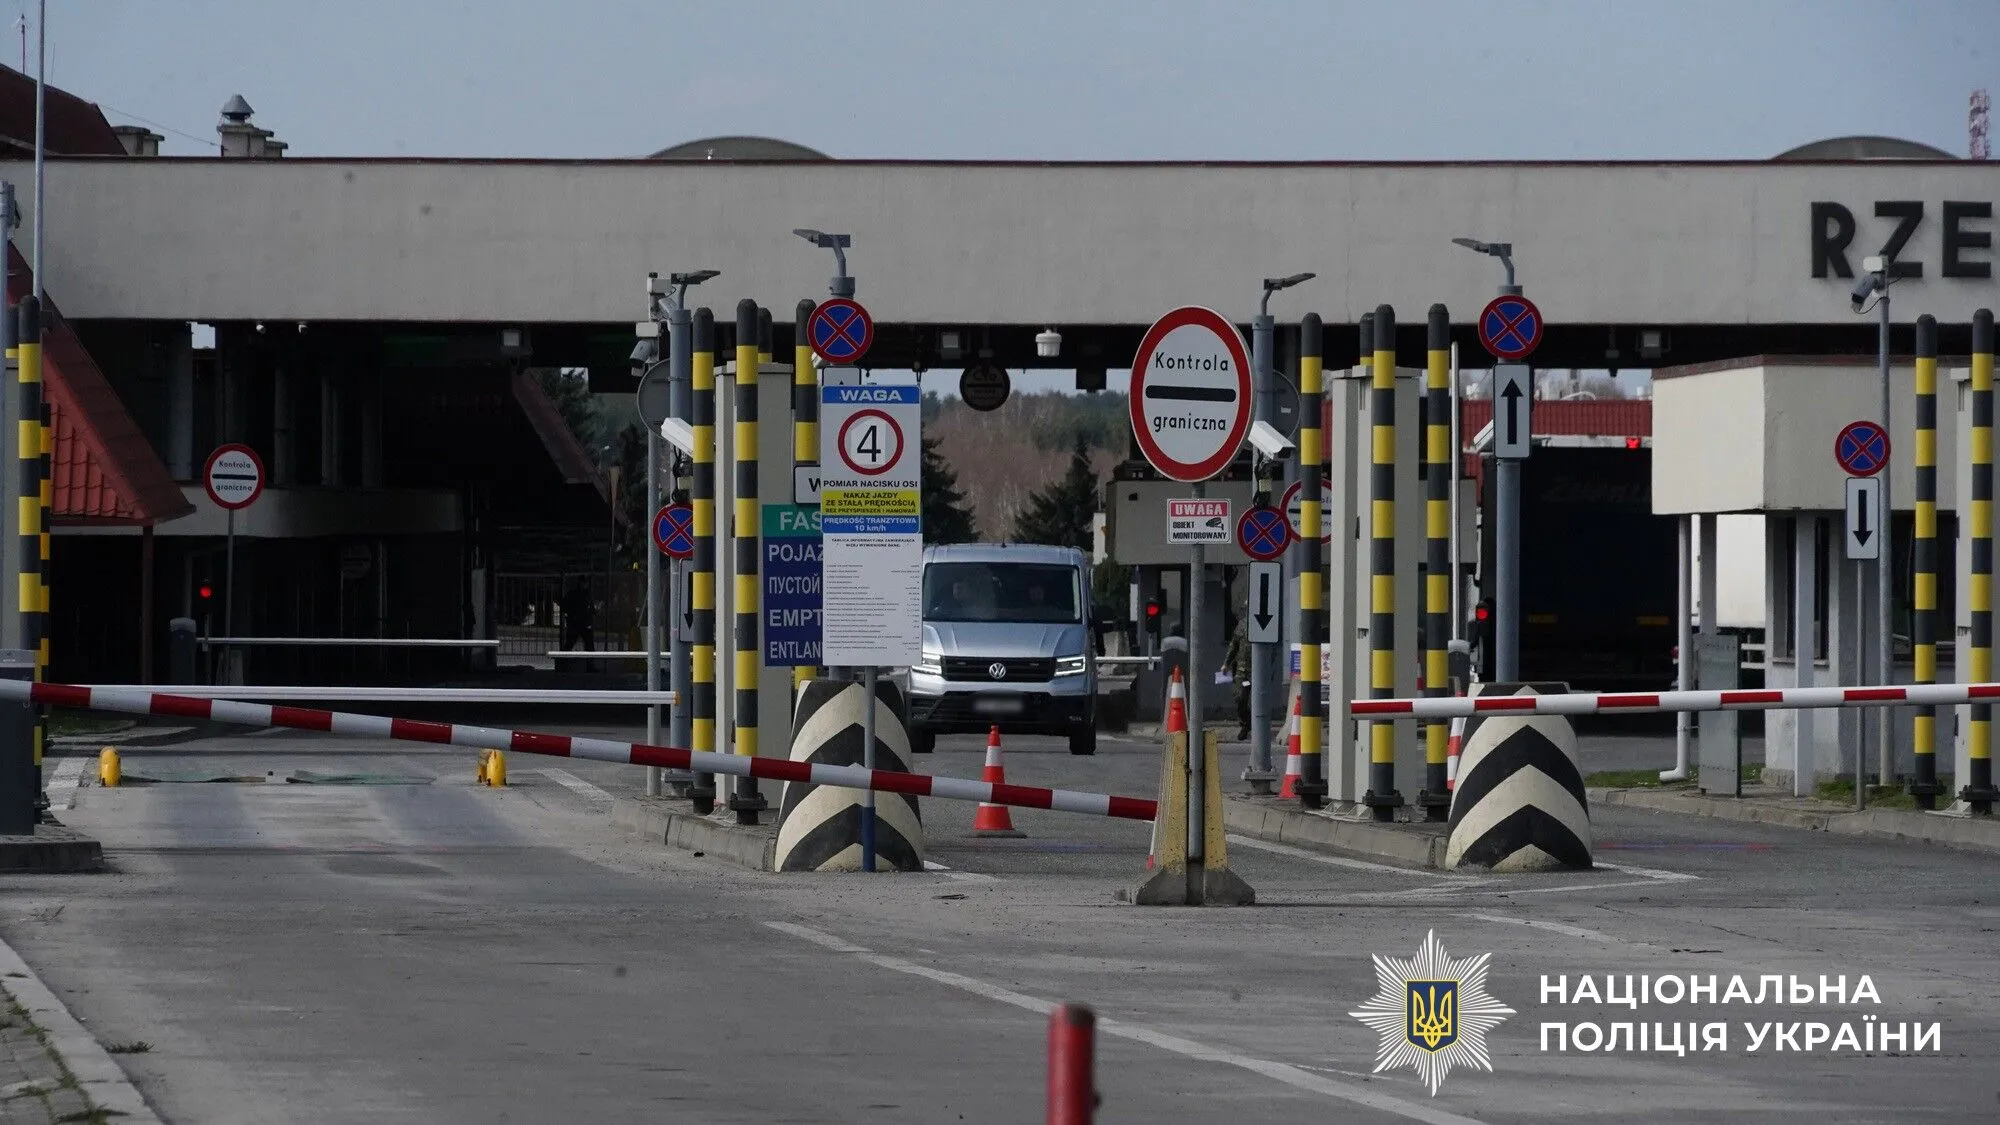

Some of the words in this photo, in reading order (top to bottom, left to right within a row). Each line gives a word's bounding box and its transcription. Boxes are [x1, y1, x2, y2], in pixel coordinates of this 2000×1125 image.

[1811, 200, 1992, 278] RZE
[1155, 352, 1229, 371] Kontrola
[841, 389, 903, 401] WAGA
[1153, 412, 1226, 433] graniczna
[857, 425, 881, 462] 4
[216, 484, 252, 492] graniczna
[860, 480, 900, 488] NACISKU
[864, 499, 916, 507] PRĘDKOŚCIĄ
[1175, 503, 1222, 515] UWAGA
[780, 511, 823, 531] FAS
[769, 574, 820, 594] ПУСТОЙ
